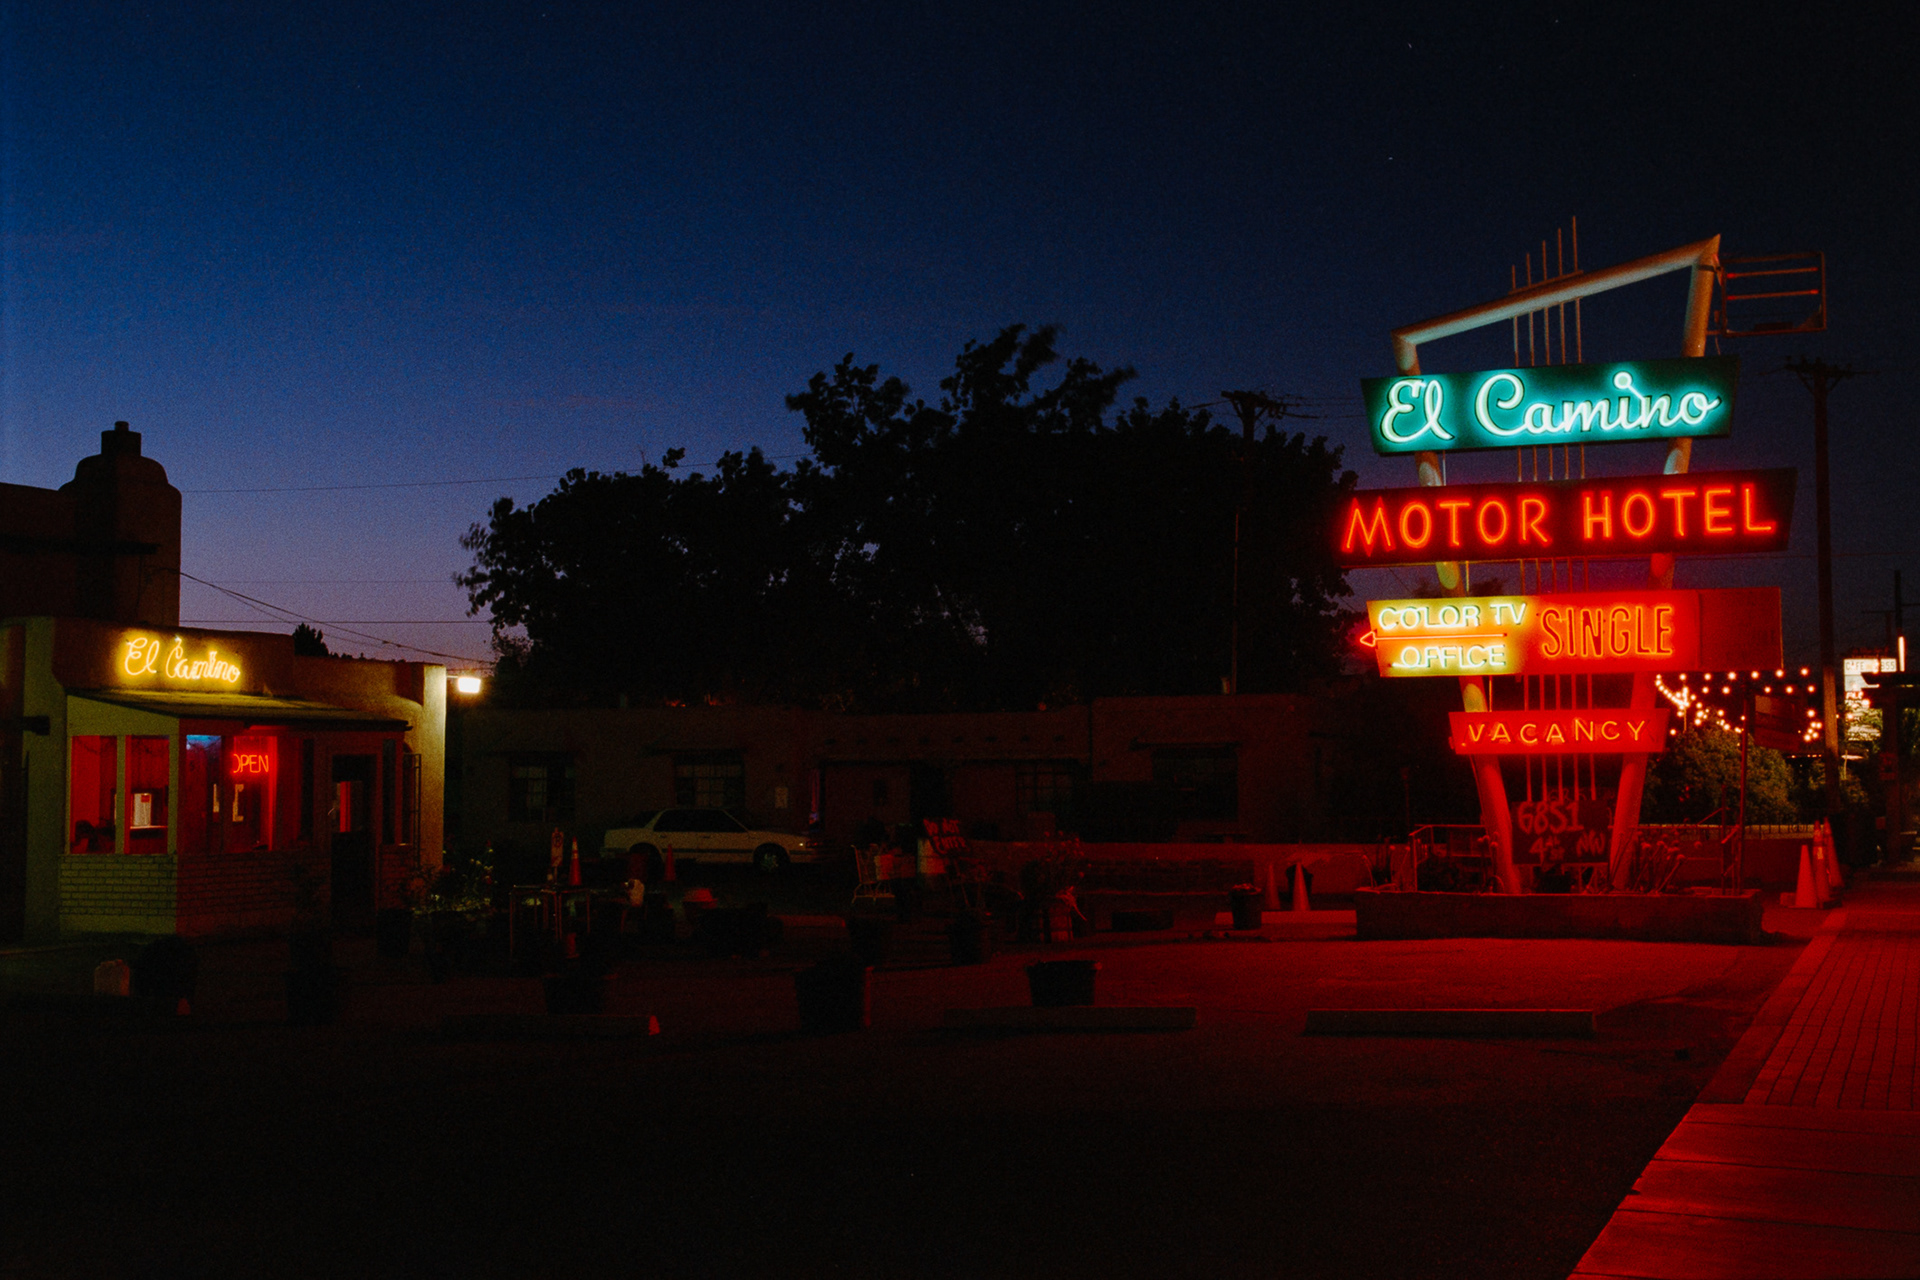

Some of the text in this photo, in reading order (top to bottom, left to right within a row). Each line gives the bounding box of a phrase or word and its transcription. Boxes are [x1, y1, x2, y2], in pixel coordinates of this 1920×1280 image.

[1381, 373, 1722, 443] El Camino
[1342, 482, 1777, 556] MOTOR HOTEL
[1378, 603, 1528, 630] COLOR TV
[1540, 606, 1674, 657] SINGLE
[124, 637, 240, 682] El Camino
[1399, 645, 1507, 668] OFFICE
[1467, 718, 1646, 744] VACANCY
[1518, 801, 1584, 835] 6851
